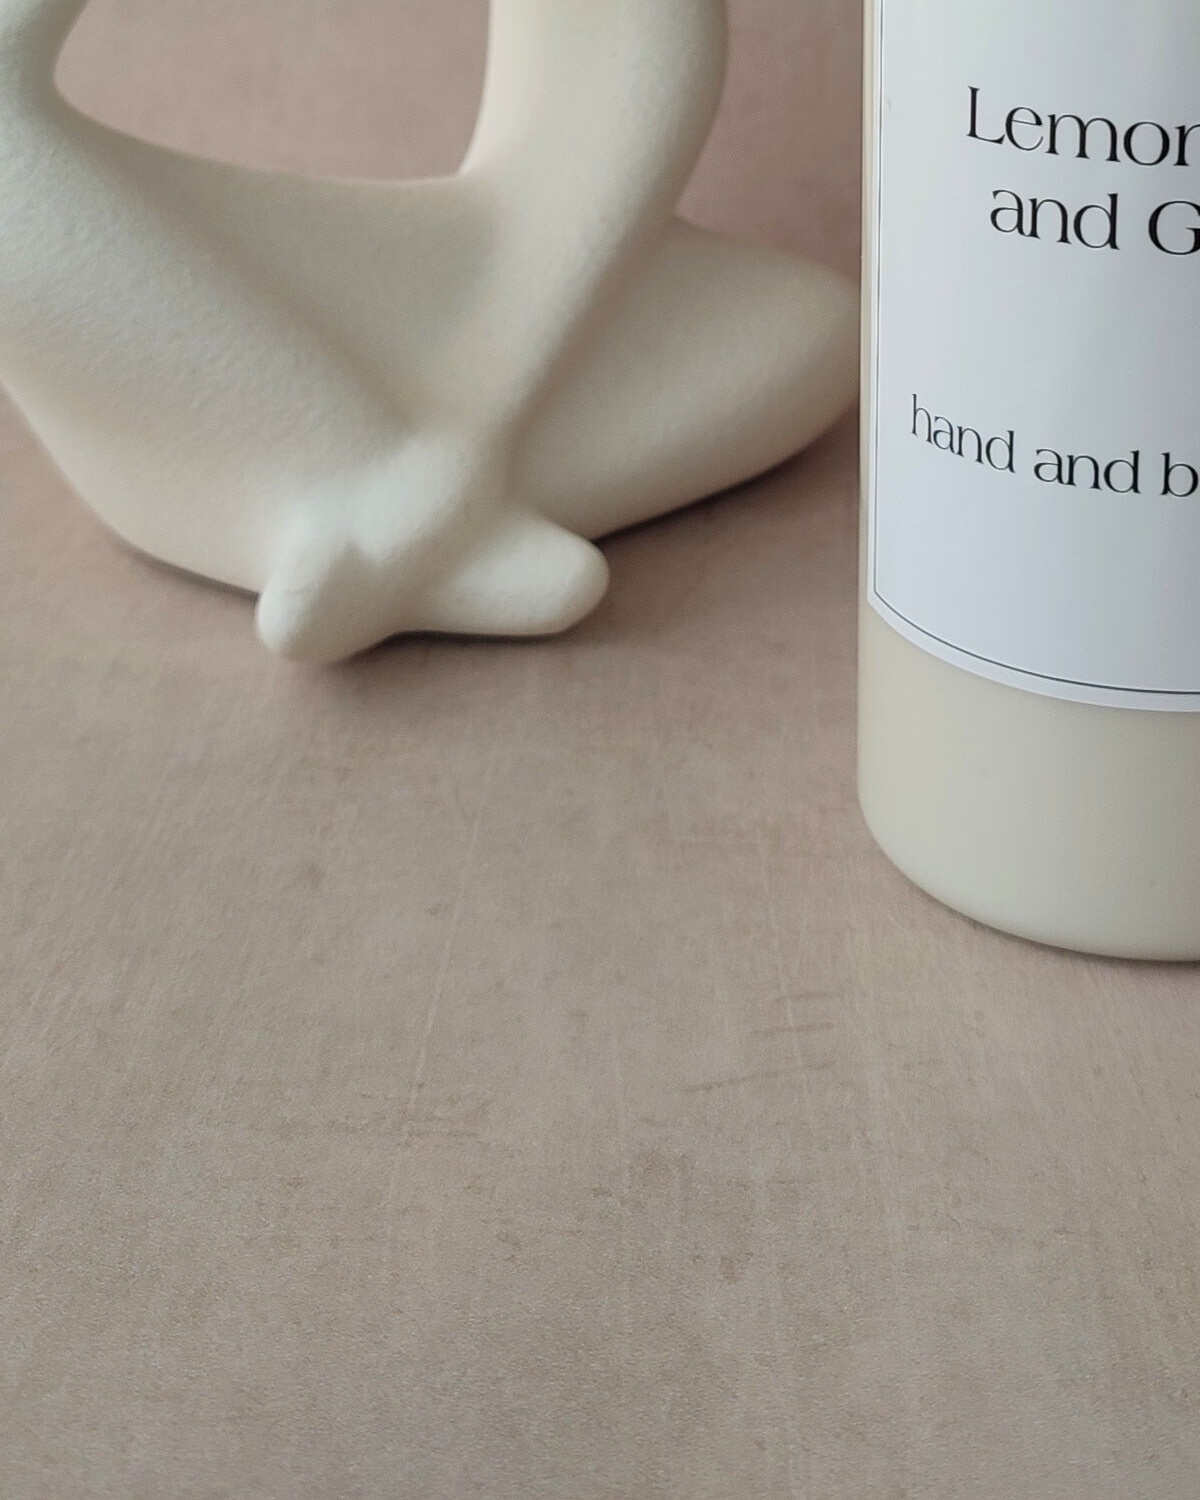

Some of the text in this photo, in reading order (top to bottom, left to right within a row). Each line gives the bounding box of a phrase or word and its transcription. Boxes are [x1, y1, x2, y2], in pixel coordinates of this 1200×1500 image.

[990, 188, 1120, 251] and
[911, 393, 1015, 473] hand
[1033, 448, 1141, 494] and
